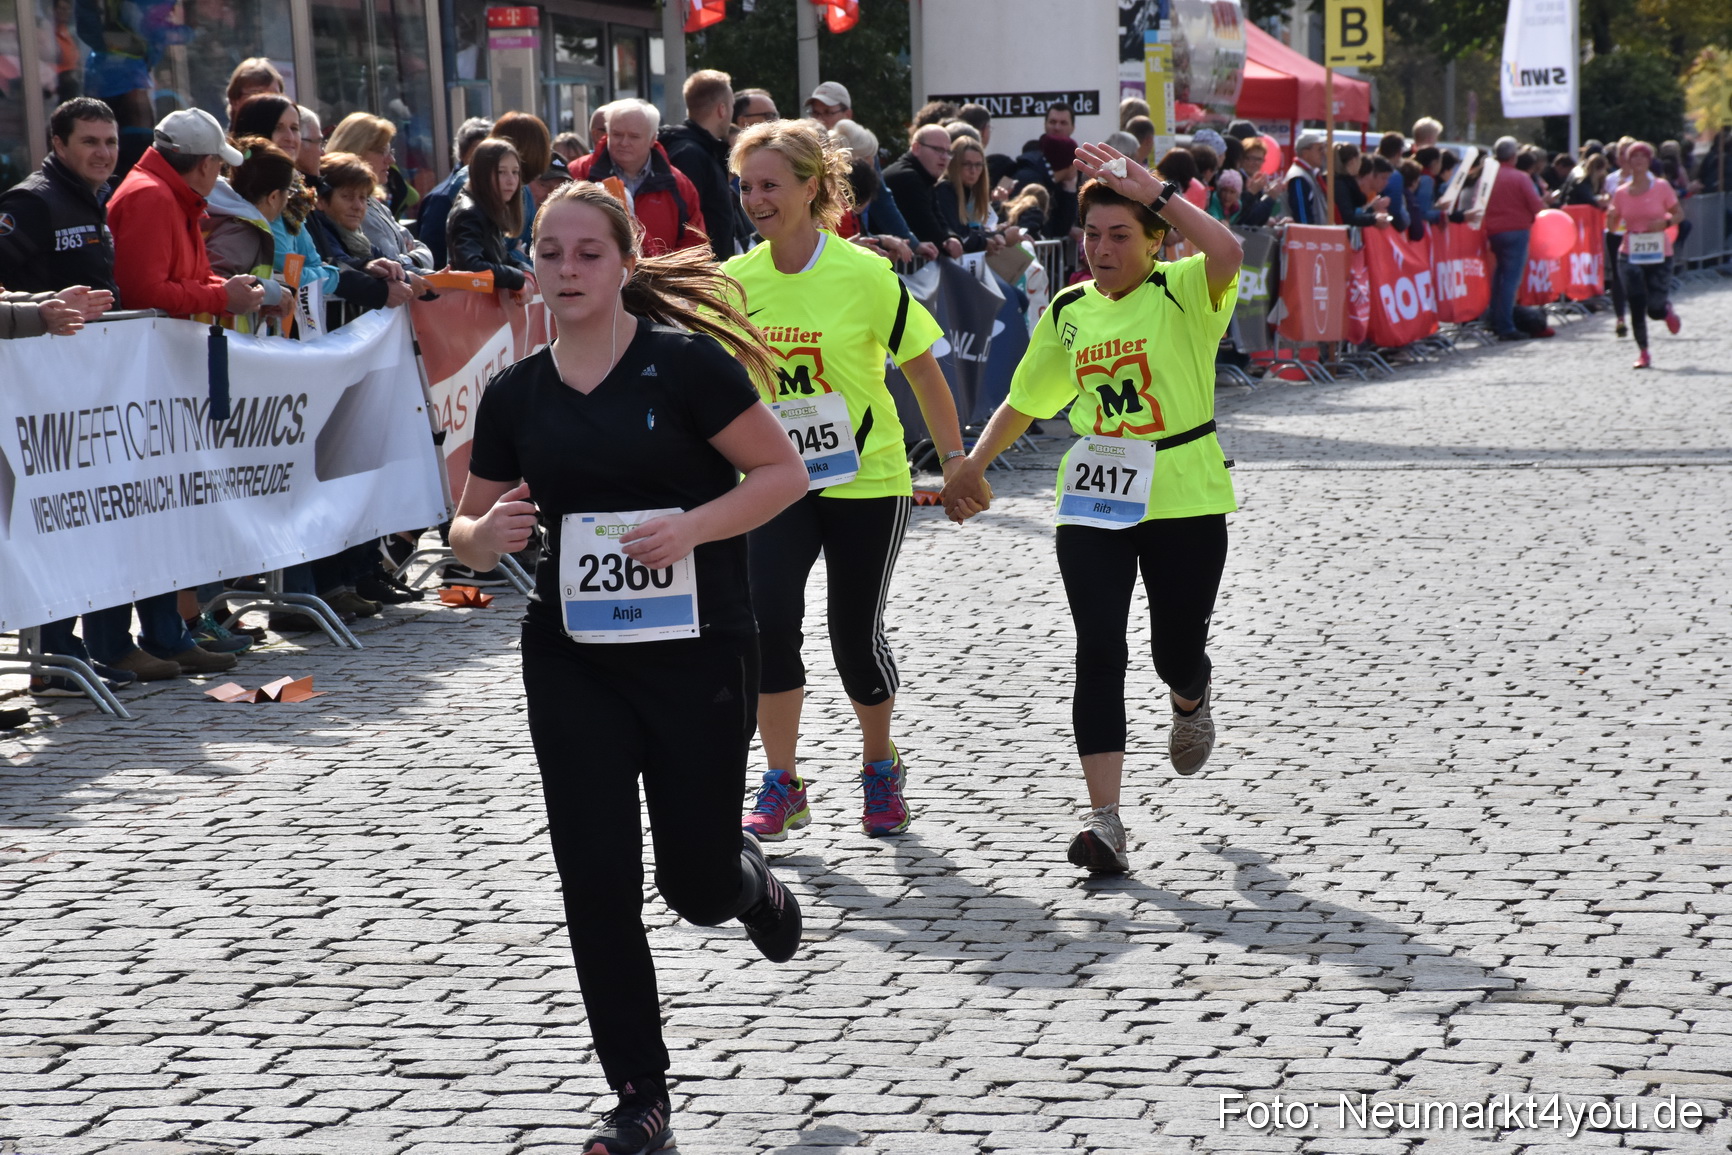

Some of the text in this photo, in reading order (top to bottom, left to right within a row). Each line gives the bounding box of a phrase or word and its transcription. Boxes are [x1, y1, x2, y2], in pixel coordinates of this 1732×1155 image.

[1341, 7, 1368, 48] B
[55, 234, 83, 252] 1963
[1075, 338, 1147, 368] Müller
[772, 365, 816, 395] M
[787, 405, 818, 417] BOCK
[1096, 379, 1143, 418] M
[15, 410, 75, 477] BMW
[788, 422, 839, 456] 045
[1096, 444, 1126, 456] BOCK
[808, 462, 829, 475] nika
[1075, 463, 1138, 496] 2417
[30, 490, 91, 535] WENIGER
[87, 474, 178, 524] VERBRAUCH.
[1093, 502, 1112, 514] Rita
[579, 553, 673, 593] 2360
[612, 606, 643, 623] Anja
